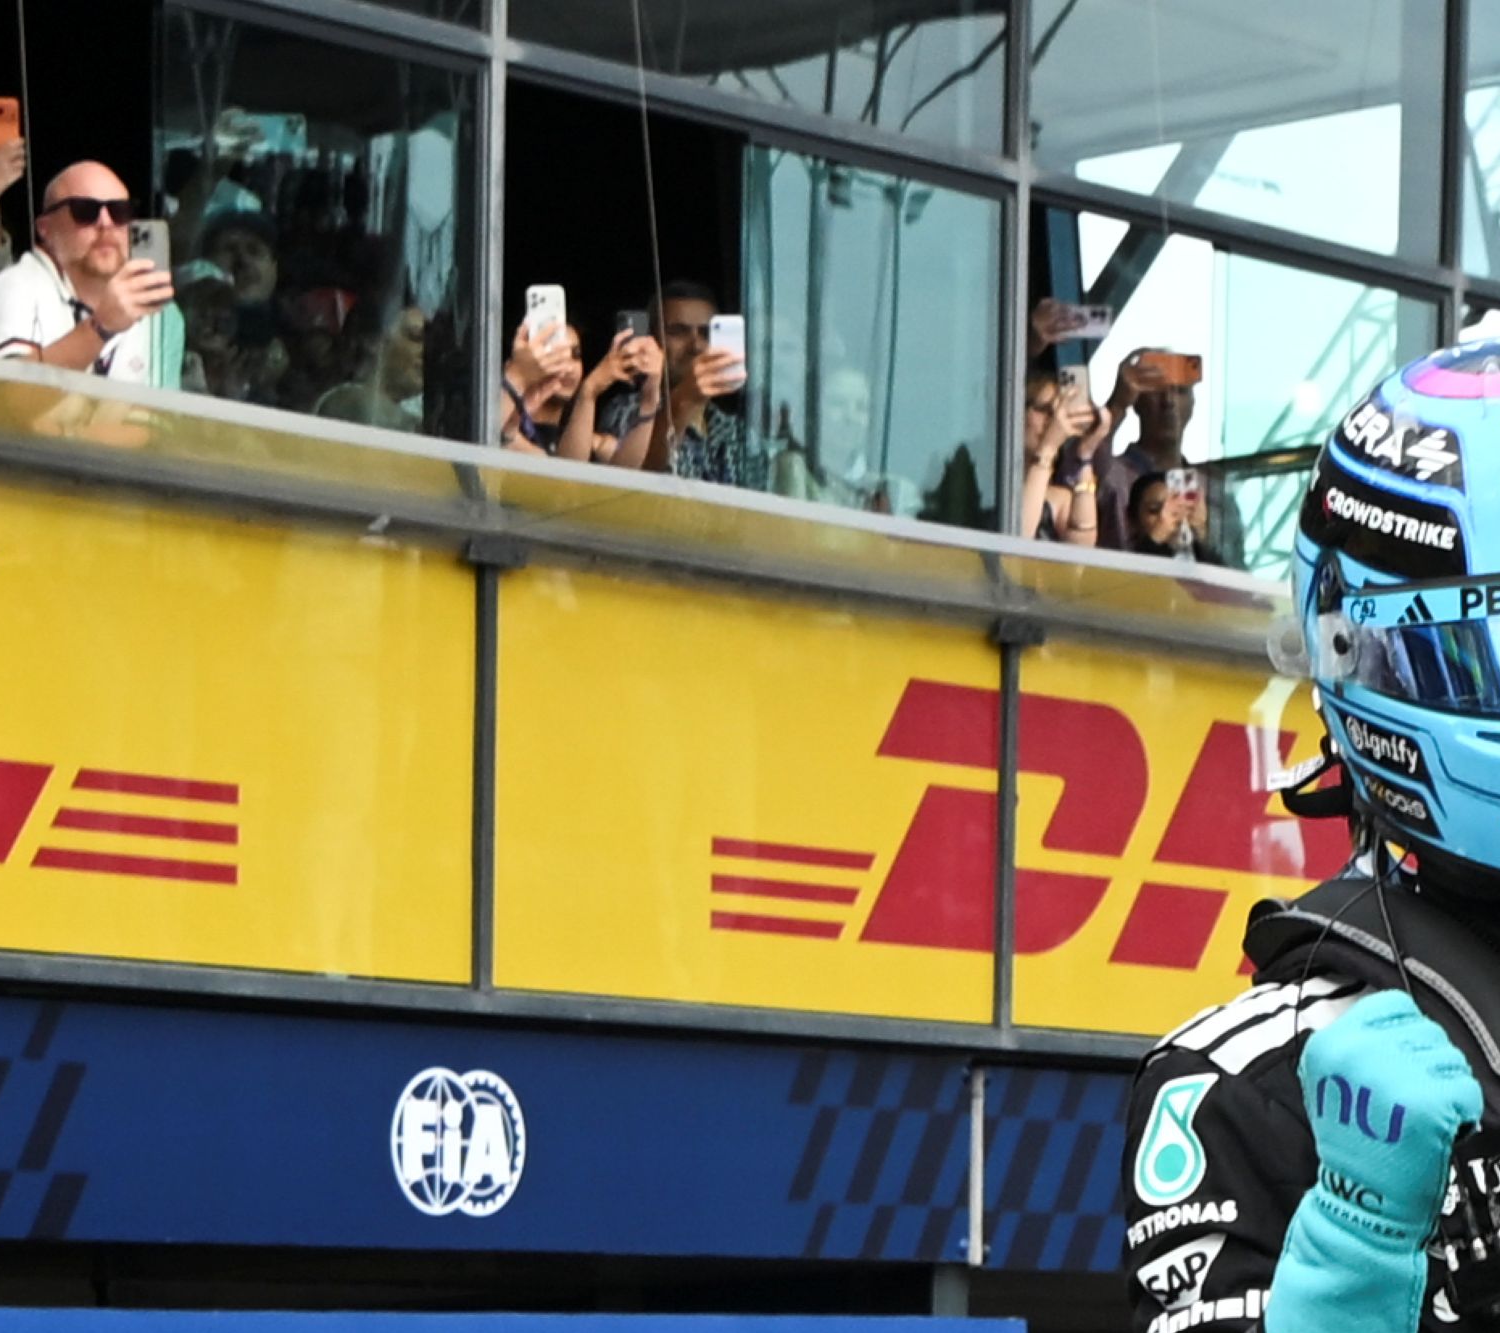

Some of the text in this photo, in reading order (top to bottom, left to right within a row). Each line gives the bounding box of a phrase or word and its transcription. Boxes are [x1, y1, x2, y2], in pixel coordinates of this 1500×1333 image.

[1326, 487, 1458, 550] CROWDSTRIKE
[1126, 1199, 1238, 1250] PETRONAS
[1146, 1250, 1208, 1302] SAP
